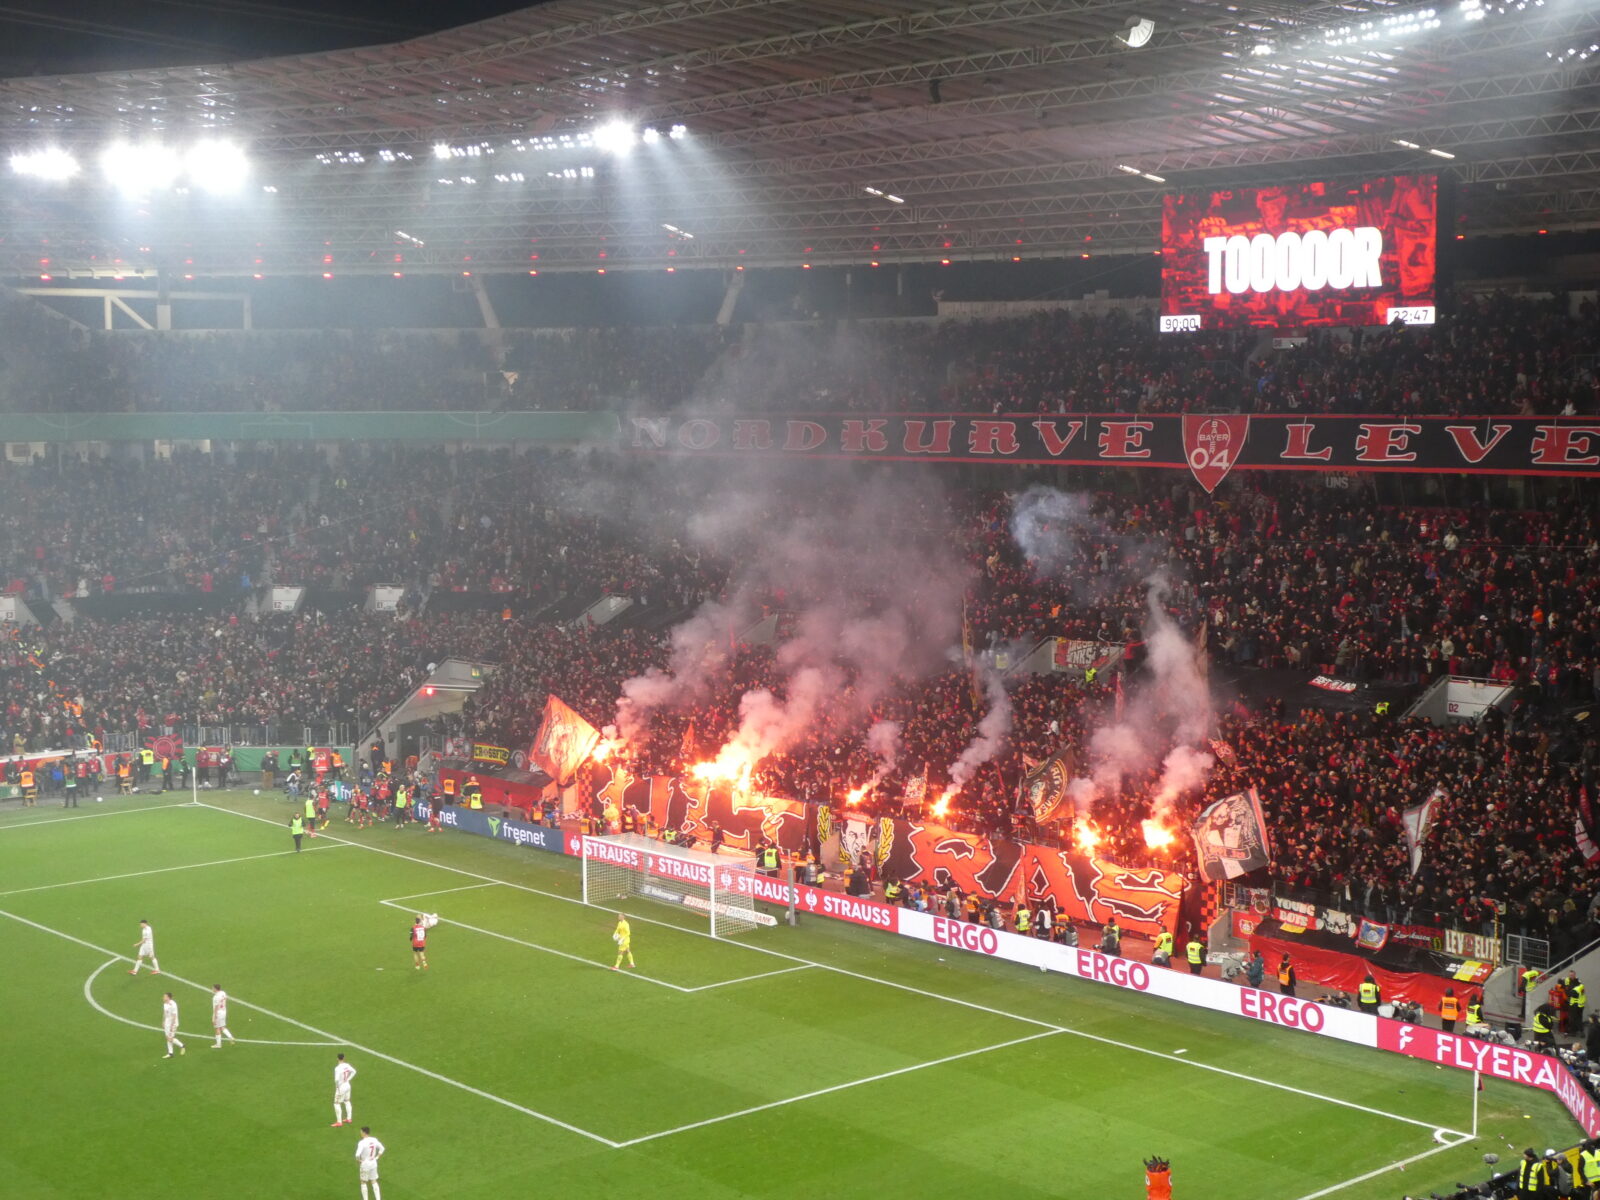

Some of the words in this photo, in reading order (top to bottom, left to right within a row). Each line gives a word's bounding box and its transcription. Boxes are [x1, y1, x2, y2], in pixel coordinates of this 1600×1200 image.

[1204, 227, 1382, 294] TOOOOOR
[631, 416, 1153, 458] NORDKURVE
[1281, 424, 1600, 465] LEVE
[1190, 447, 1230, 470] 04
[418, 803, 458, 826] frnet
[503, 822, 546, 847] freenet
[585, 840, 638, 867] STRAUSS
[823, 895, 891, 926] STRAUSS
[933, 916, 998, 955] ERGO
[1445, 929, 1464, 954] LEV
[1077, 950, 1149, 991] ERGO
[1240, 987, 1324, 1033] ERGO
